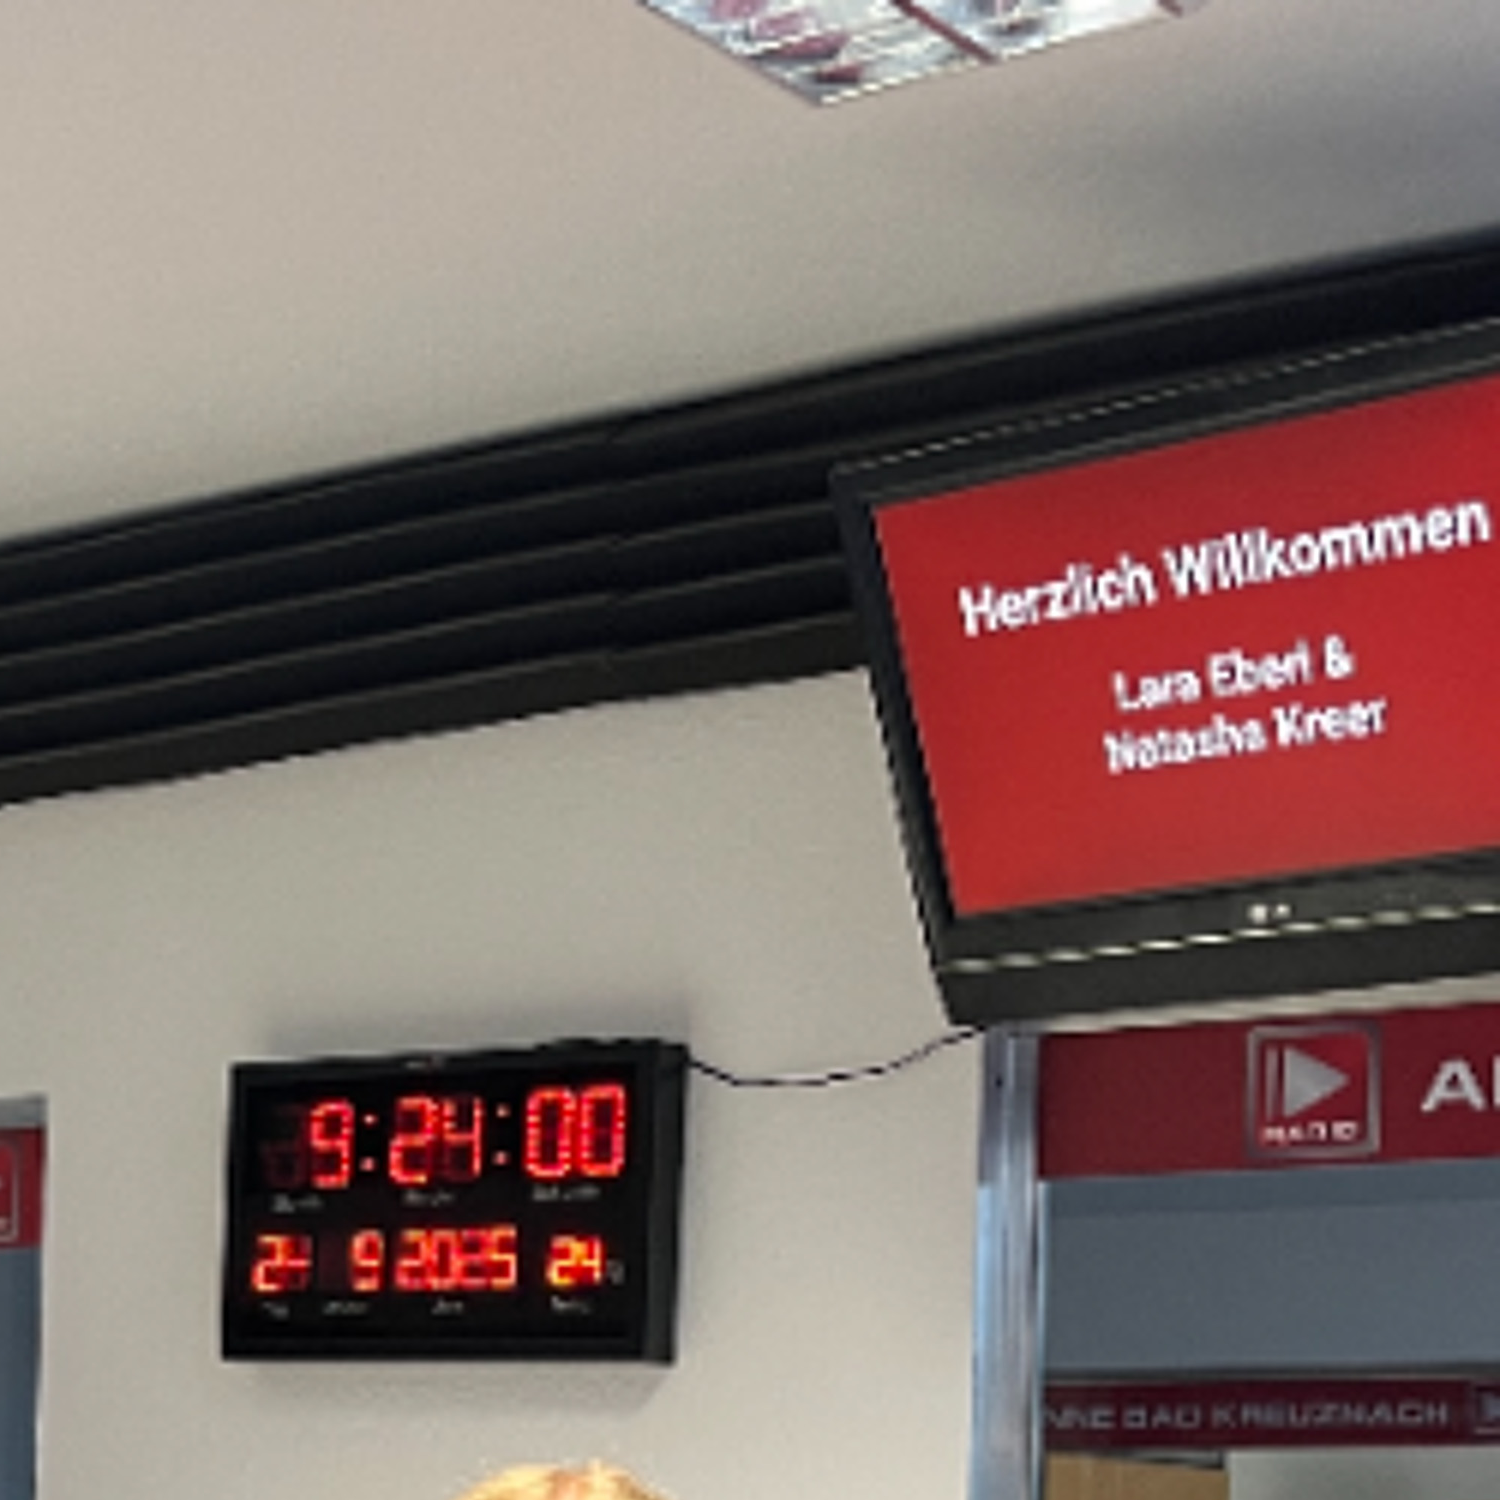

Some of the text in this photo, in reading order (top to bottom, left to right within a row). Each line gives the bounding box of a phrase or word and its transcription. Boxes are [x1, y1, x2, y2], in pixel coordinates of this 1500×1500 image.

[958, 500, 1491, 636] Herzlich Willkommen
[1111, 670, 1201, 712] Lara
[1323, 634, 1356, 680] &
[1102, 712, 1268, 775] Natasha
